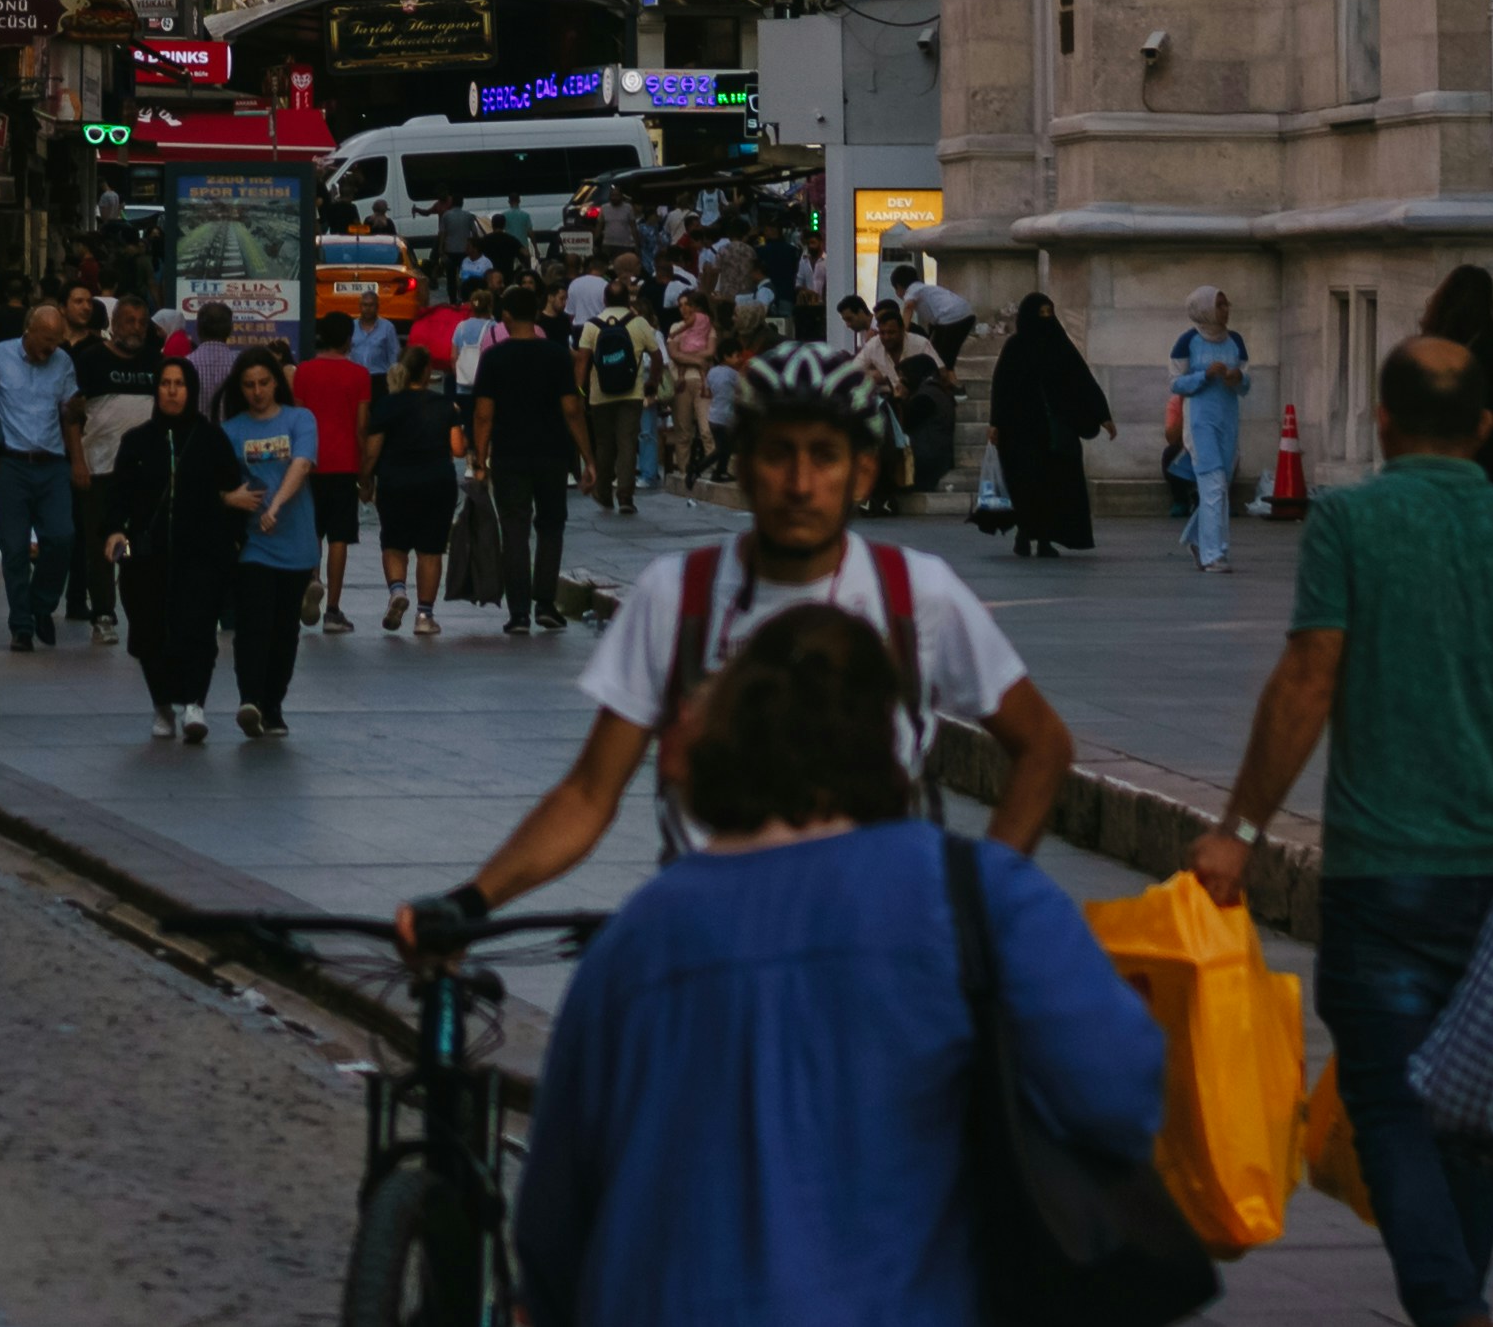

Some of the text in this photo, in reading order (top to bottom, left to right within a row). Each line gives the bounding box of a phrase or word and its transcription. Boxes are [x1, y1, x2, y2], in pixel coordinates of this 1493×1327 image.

[189, 187, 233, 197] SPOR
[887, 197, 913, 208] DEV
[865, 210, 935, 222] KAMPANYA
[109, 369, 155, 385] QUIET
